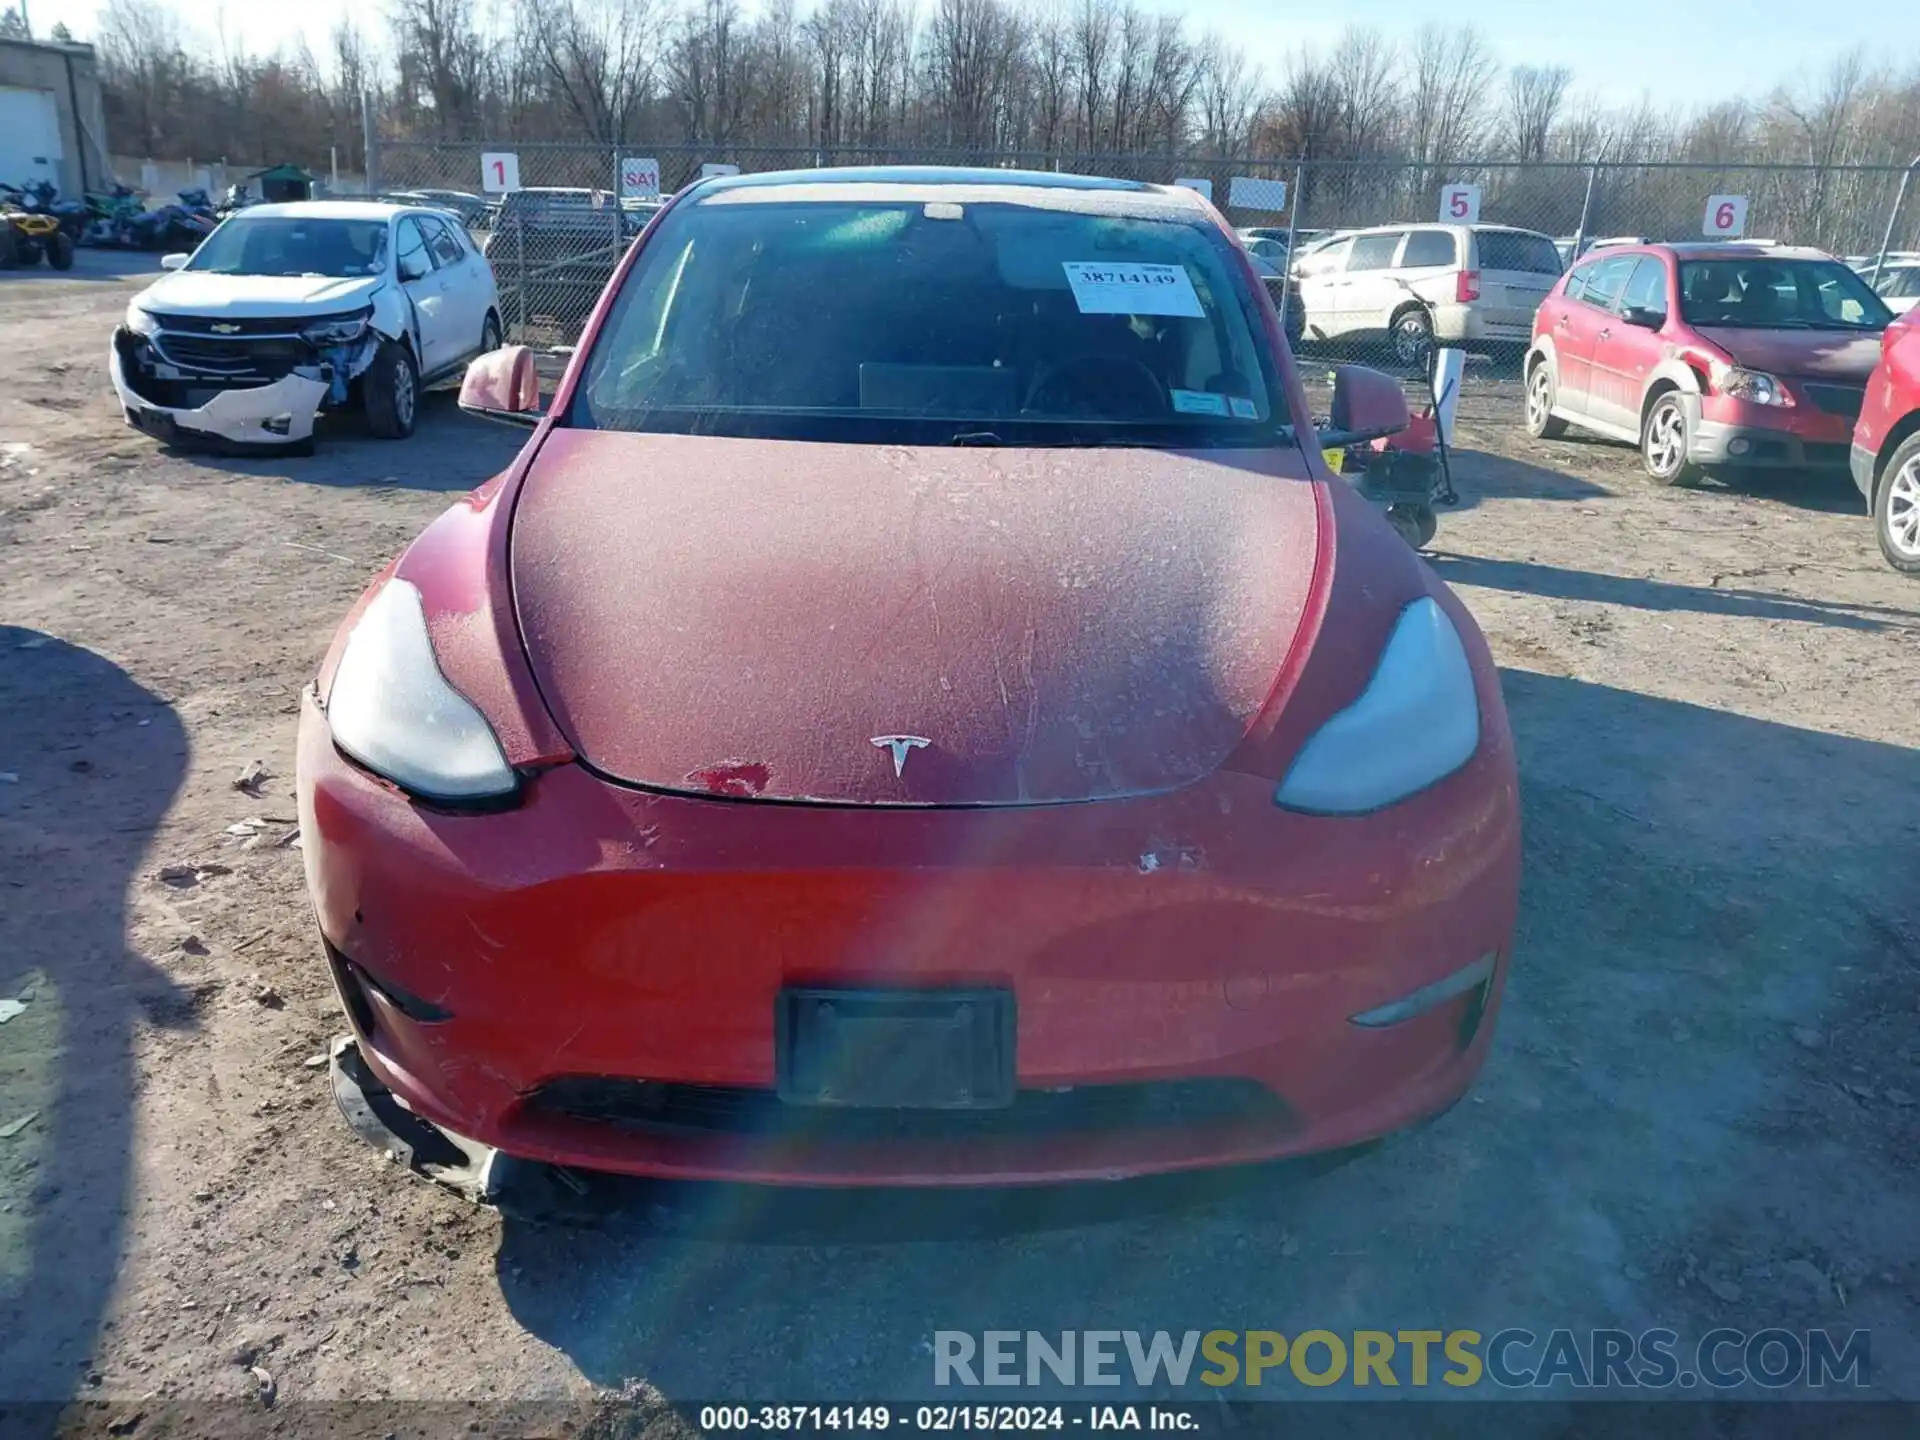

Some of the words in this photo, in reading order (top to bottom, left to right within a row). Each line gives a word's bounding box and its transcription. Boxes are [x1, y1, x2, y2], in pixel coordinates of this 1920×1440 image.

[493, 161, 506, 186] 1
[625, 171, 657, 188] SA1
[1449, 191, 1469, 218] 5
[1714, 201, 1735, 229] 6
[1080, 271, 1177, 286] 38714149
